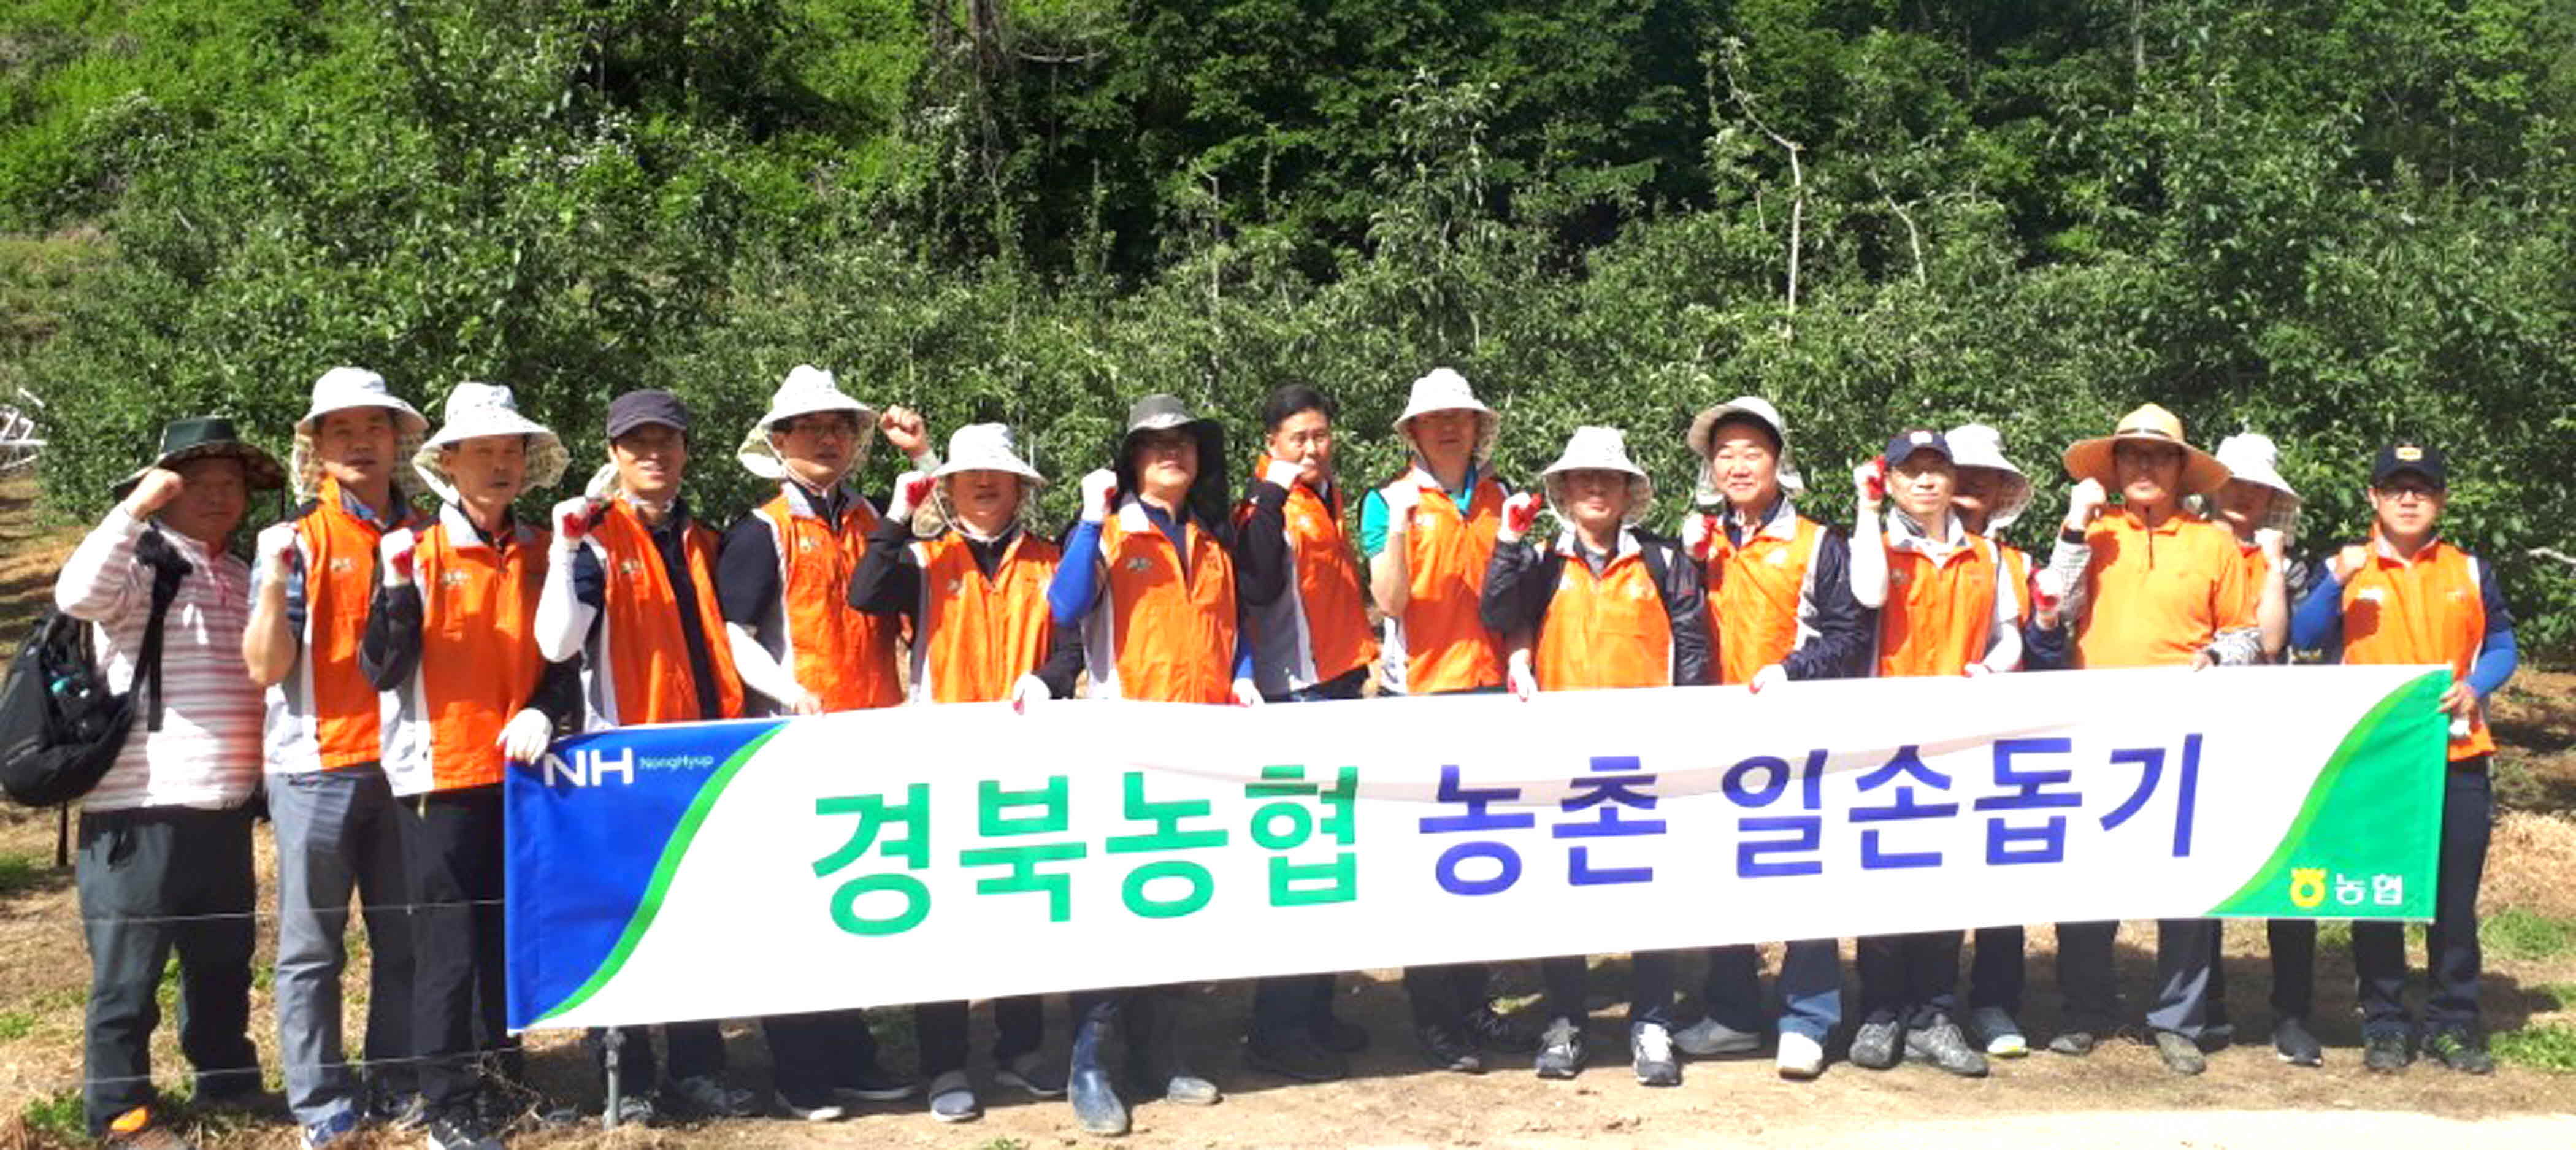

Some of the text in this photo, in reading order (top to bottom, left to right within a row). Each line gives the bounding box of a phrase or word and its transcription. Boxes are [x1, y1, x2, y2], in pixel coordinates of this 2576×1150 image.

[543, 746, 634, 787] NH
[811, 733, 2202, 938] 경북농협 농촌 일손돕기
